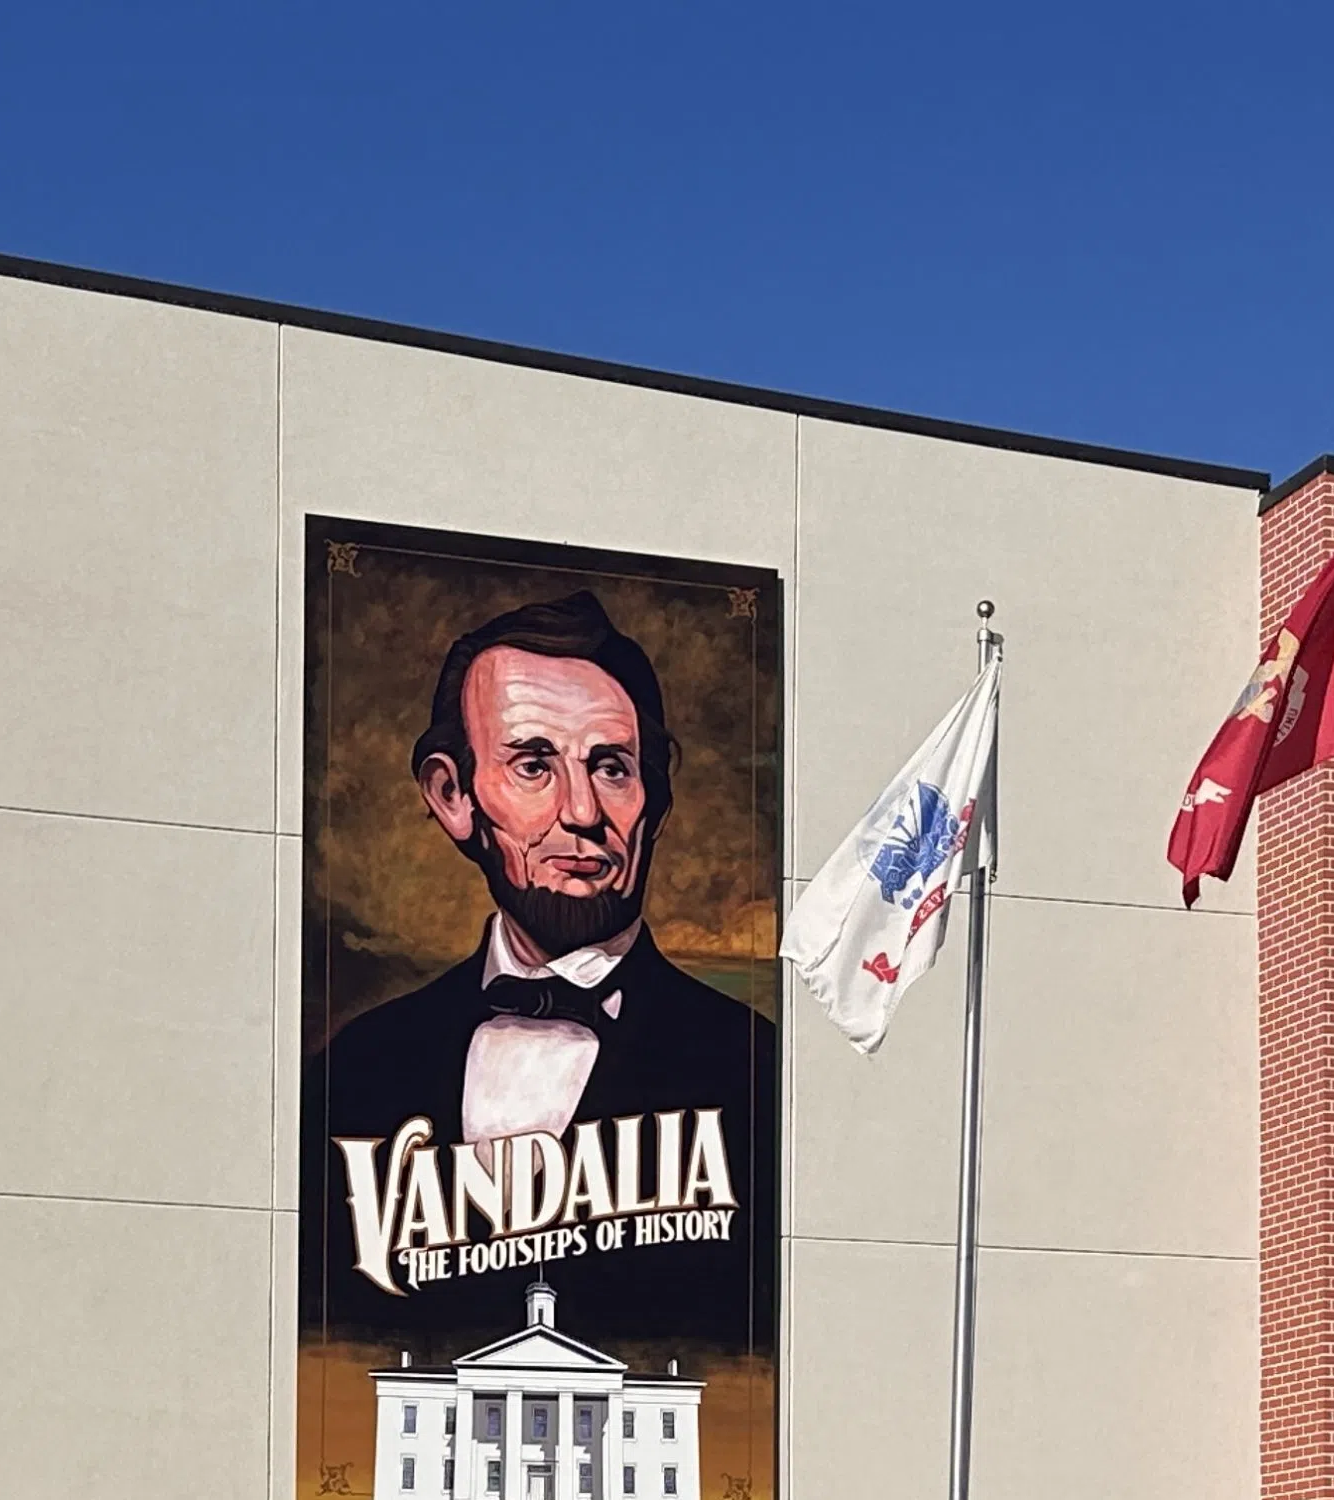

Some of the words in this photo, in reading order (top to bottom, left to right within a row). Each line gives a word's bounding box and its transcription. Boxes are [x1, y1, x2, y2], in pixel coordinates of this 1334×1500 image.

[331, 1108, 740, 1297] VANDALIA
[398, 1249, 451, 1290] THE
[458, 1224, 587, 1276] FOOTSTEPS
[596, 1217, 627, 1252] OF
[634, 1210, 734, 1247] HISTORY
